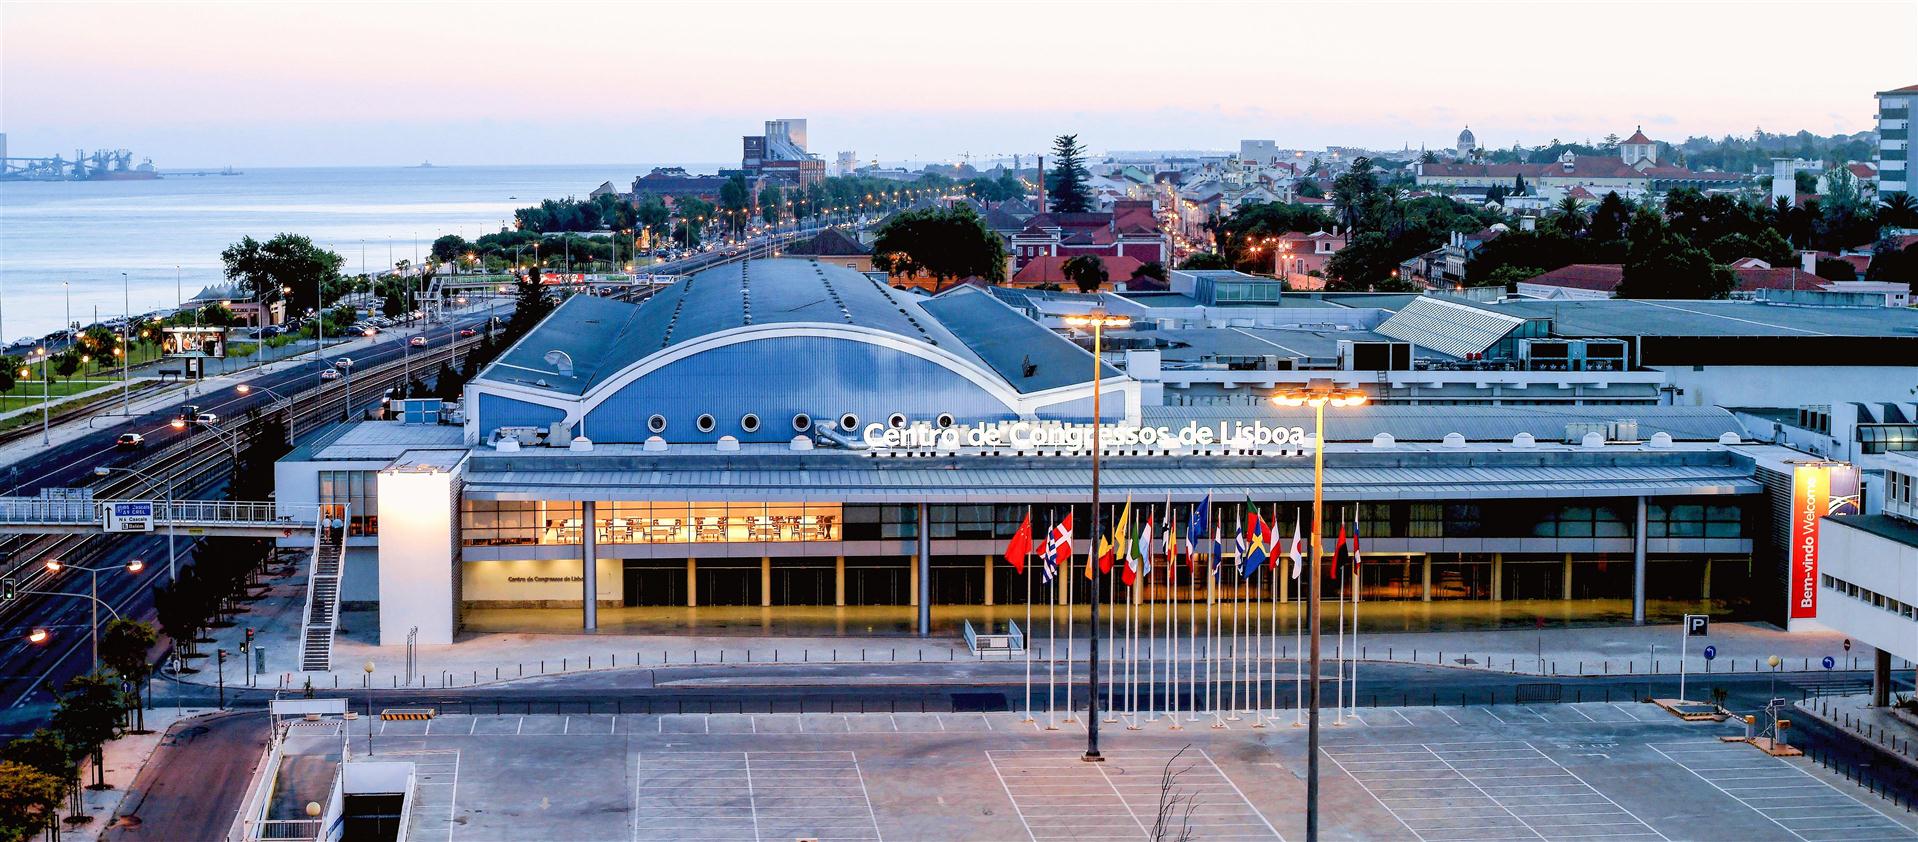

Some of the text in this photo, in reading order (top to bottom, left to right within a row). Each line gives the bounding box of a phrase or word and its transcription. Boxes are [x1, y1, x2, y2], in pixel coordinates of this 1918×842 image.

[863, 420, 1305, 451] Centro de Congressos de Lisboa
[1801, 477, 1817, 608] Bem-vindo Welcome
[1692, 618, 1705, 631] P
